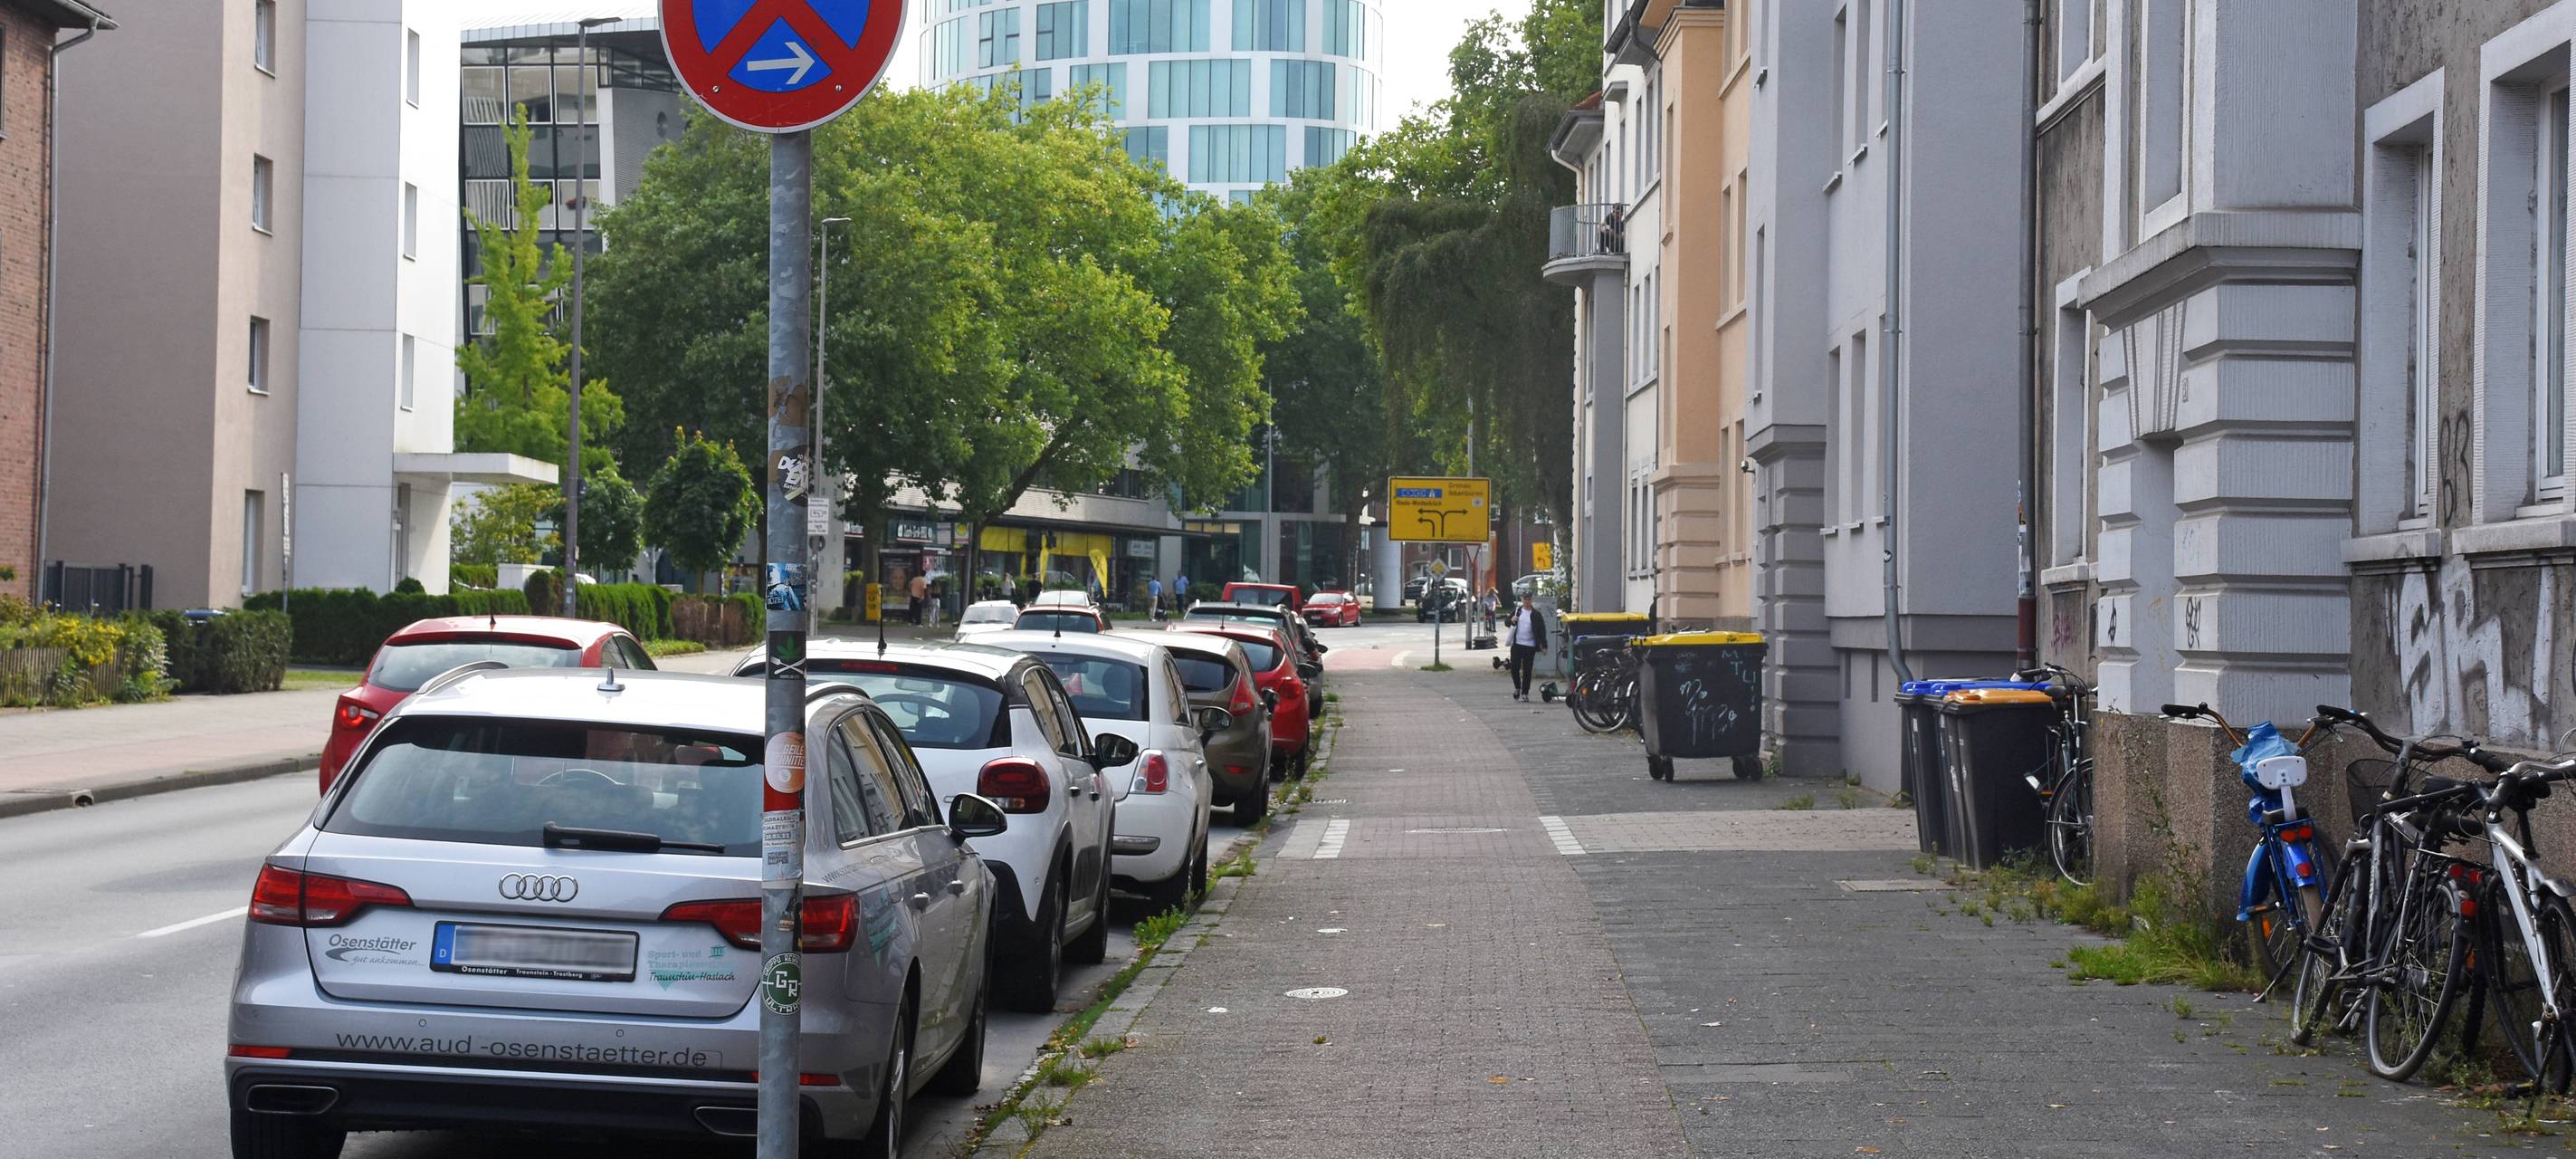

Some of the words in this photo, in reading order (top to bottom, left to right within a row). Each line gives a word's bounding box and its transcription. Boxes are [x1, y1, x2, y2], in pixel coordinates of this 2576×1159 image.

[329, 934, 417, 951] Osenstätter
[439, 948, 447, 958] D
[648, 950, 680, 960] Sport-
[682, 950, 701, 958] und
[349, 955, 367, 966] gut
[461, 965, 508, 975] Osenstätter
[649, 971, 737, 982] Traunstein-Haslach
